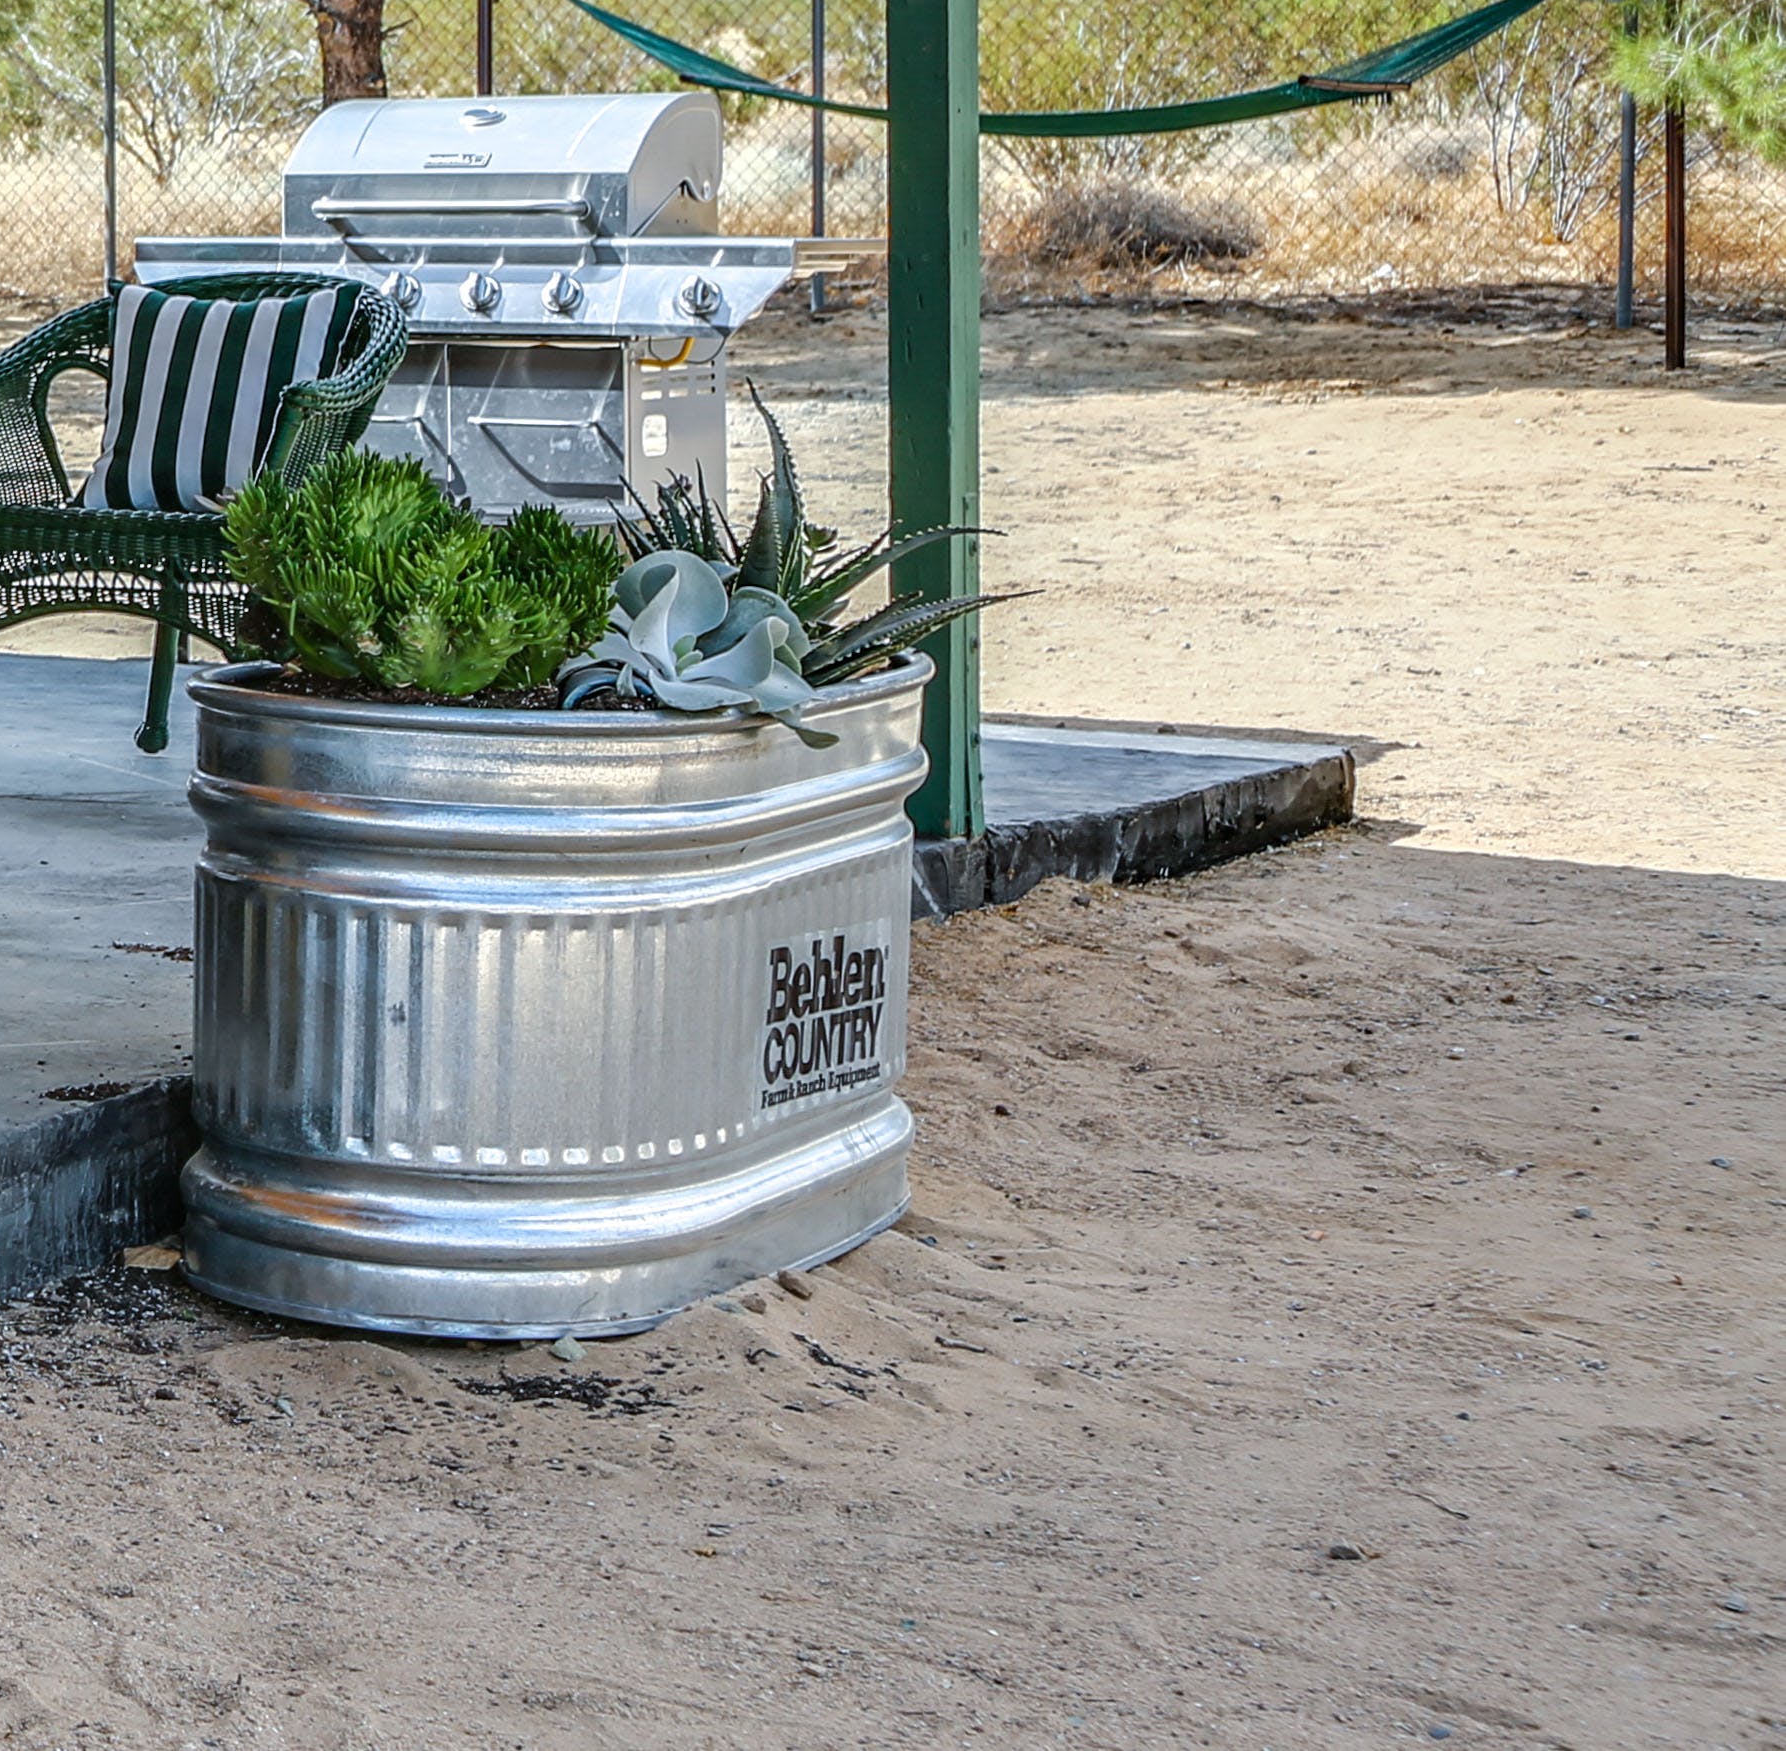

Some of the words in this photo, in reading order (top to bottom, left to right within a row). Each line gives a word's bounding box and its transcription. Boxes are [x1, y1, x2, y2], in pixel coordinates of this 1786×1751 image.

[766, 935, 885, 1025] Behlen
[763, 1002, 883, 1085] COUNTRY
[796, 1073, 826, 1098] Ranch
[828, 1062, 881, 1092] Equipment
